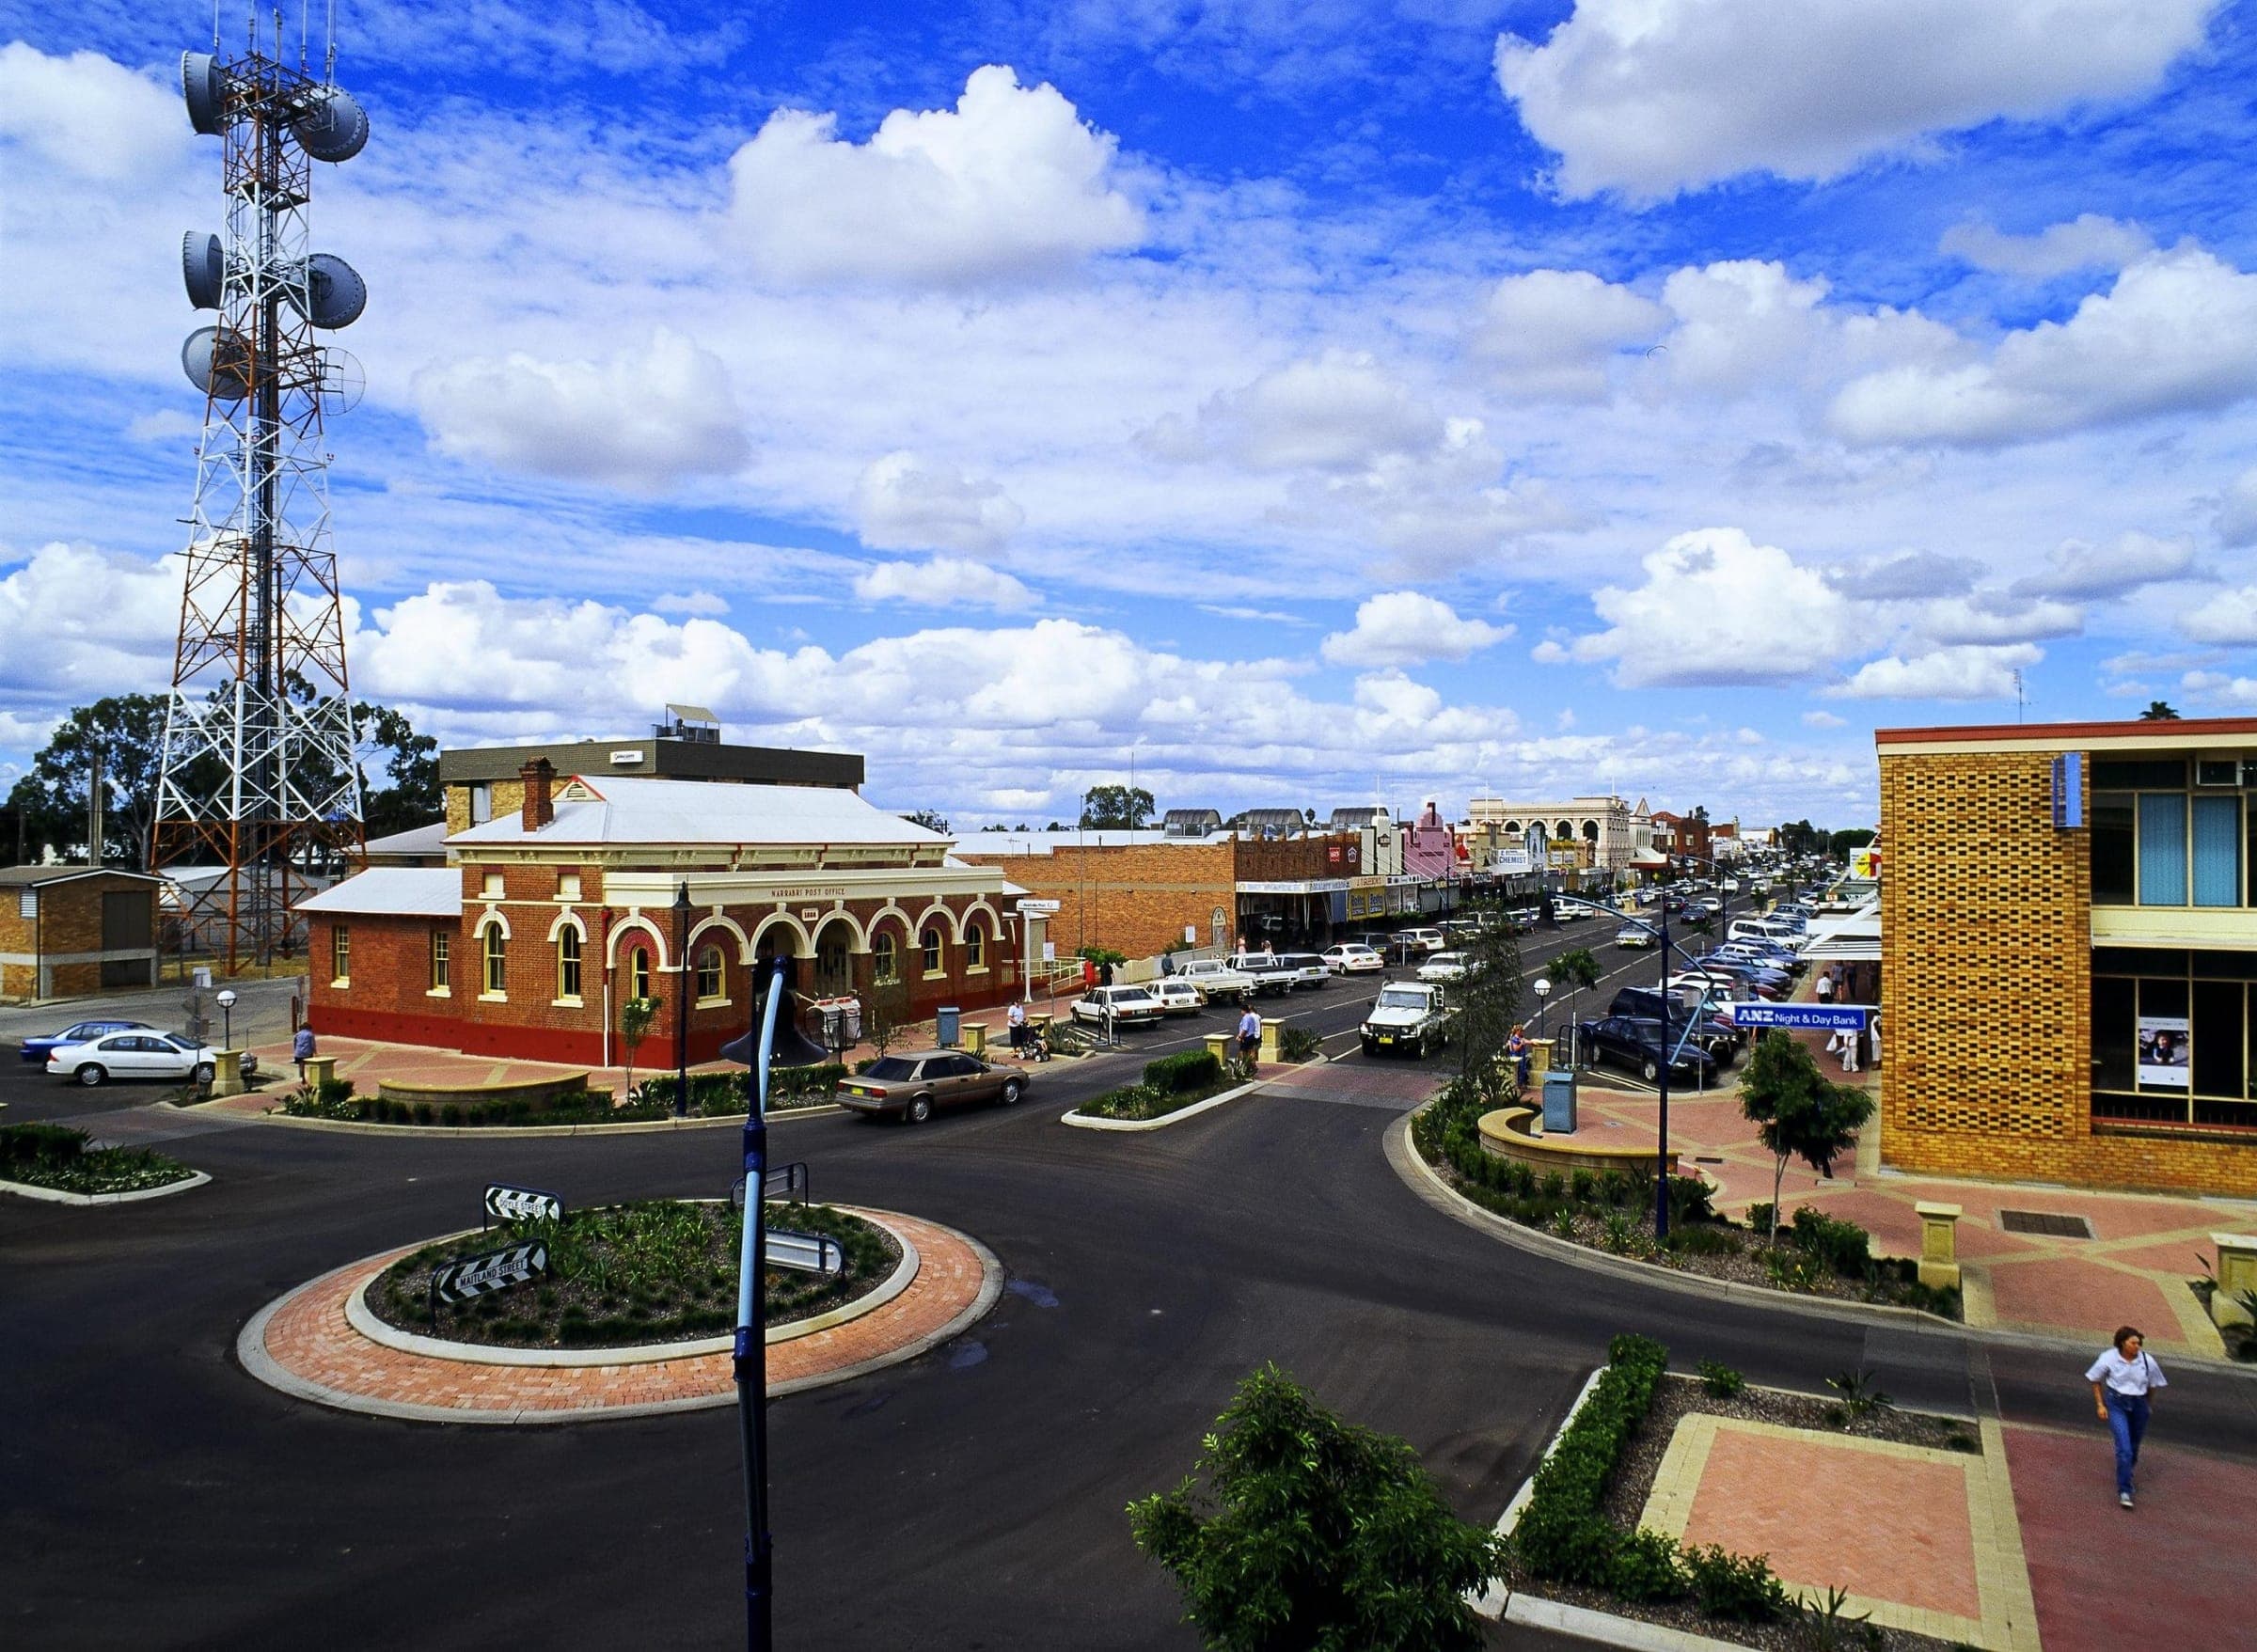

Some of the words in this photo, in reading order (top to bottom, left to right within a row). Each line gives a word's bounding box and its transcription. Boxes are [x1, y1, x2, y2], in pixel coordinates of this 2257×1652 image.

[771, 889, 802, 897] NARRABRI
[824, 888, 845, 896] OFFICE
[1738, 1009, 1774, 1022] ANZ
[1775, 1014, 1800, 1025] Night
[1802, 1014, 1810, 1023] &
[1812, 1015, 1831, 1026] Day
[1833, 1015, 1858, 1025] Bank
[499, 1198, 519, 1209] DOYLE
[520, 1203, 543, 1213] STREET
[460, 1267, 497, 1287] MAITLAND
[498, 1260, 524, 1275] STREET
